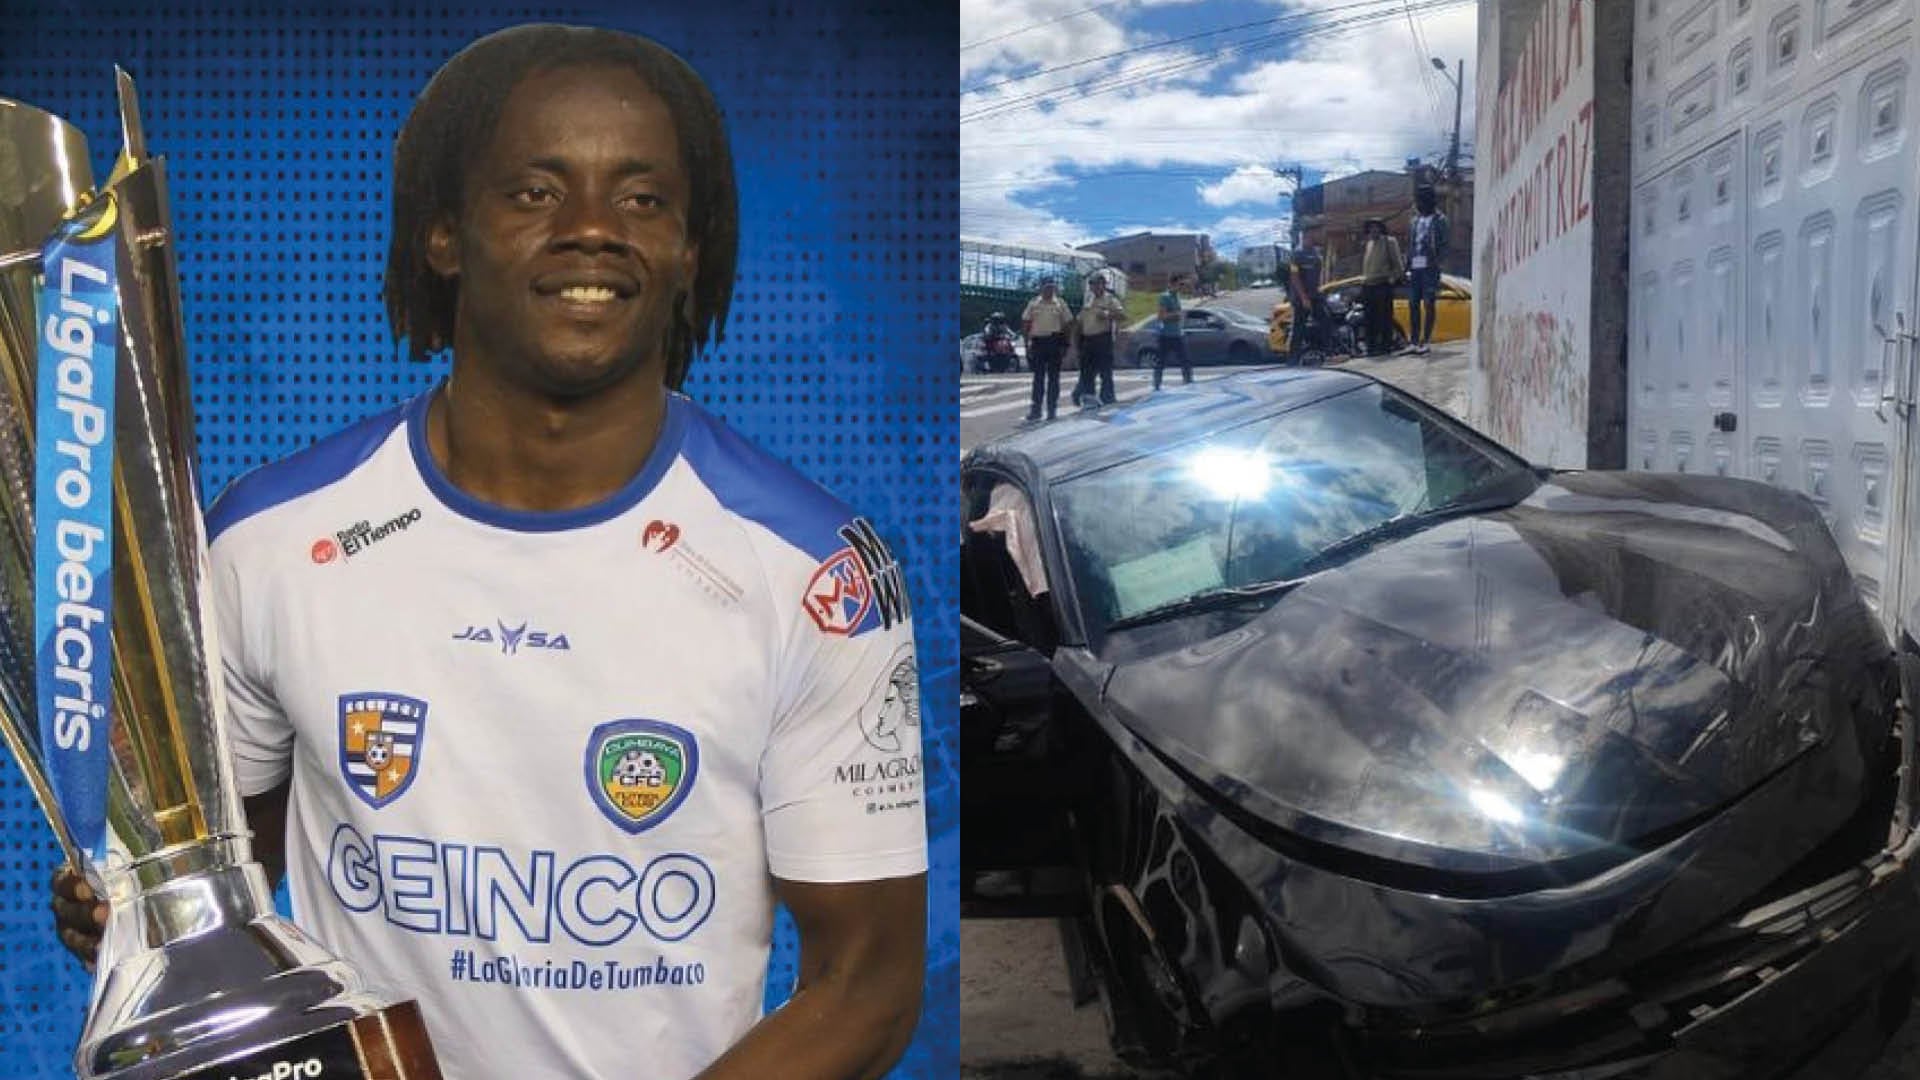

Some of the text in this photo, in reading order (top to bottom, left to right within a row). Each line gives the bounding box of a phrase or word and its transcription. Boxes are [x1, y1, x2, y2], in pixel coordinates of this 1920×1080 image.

[46, 257, 110, 752] LigaPro betcris
[329, 823, 715, 946] GEINCO
